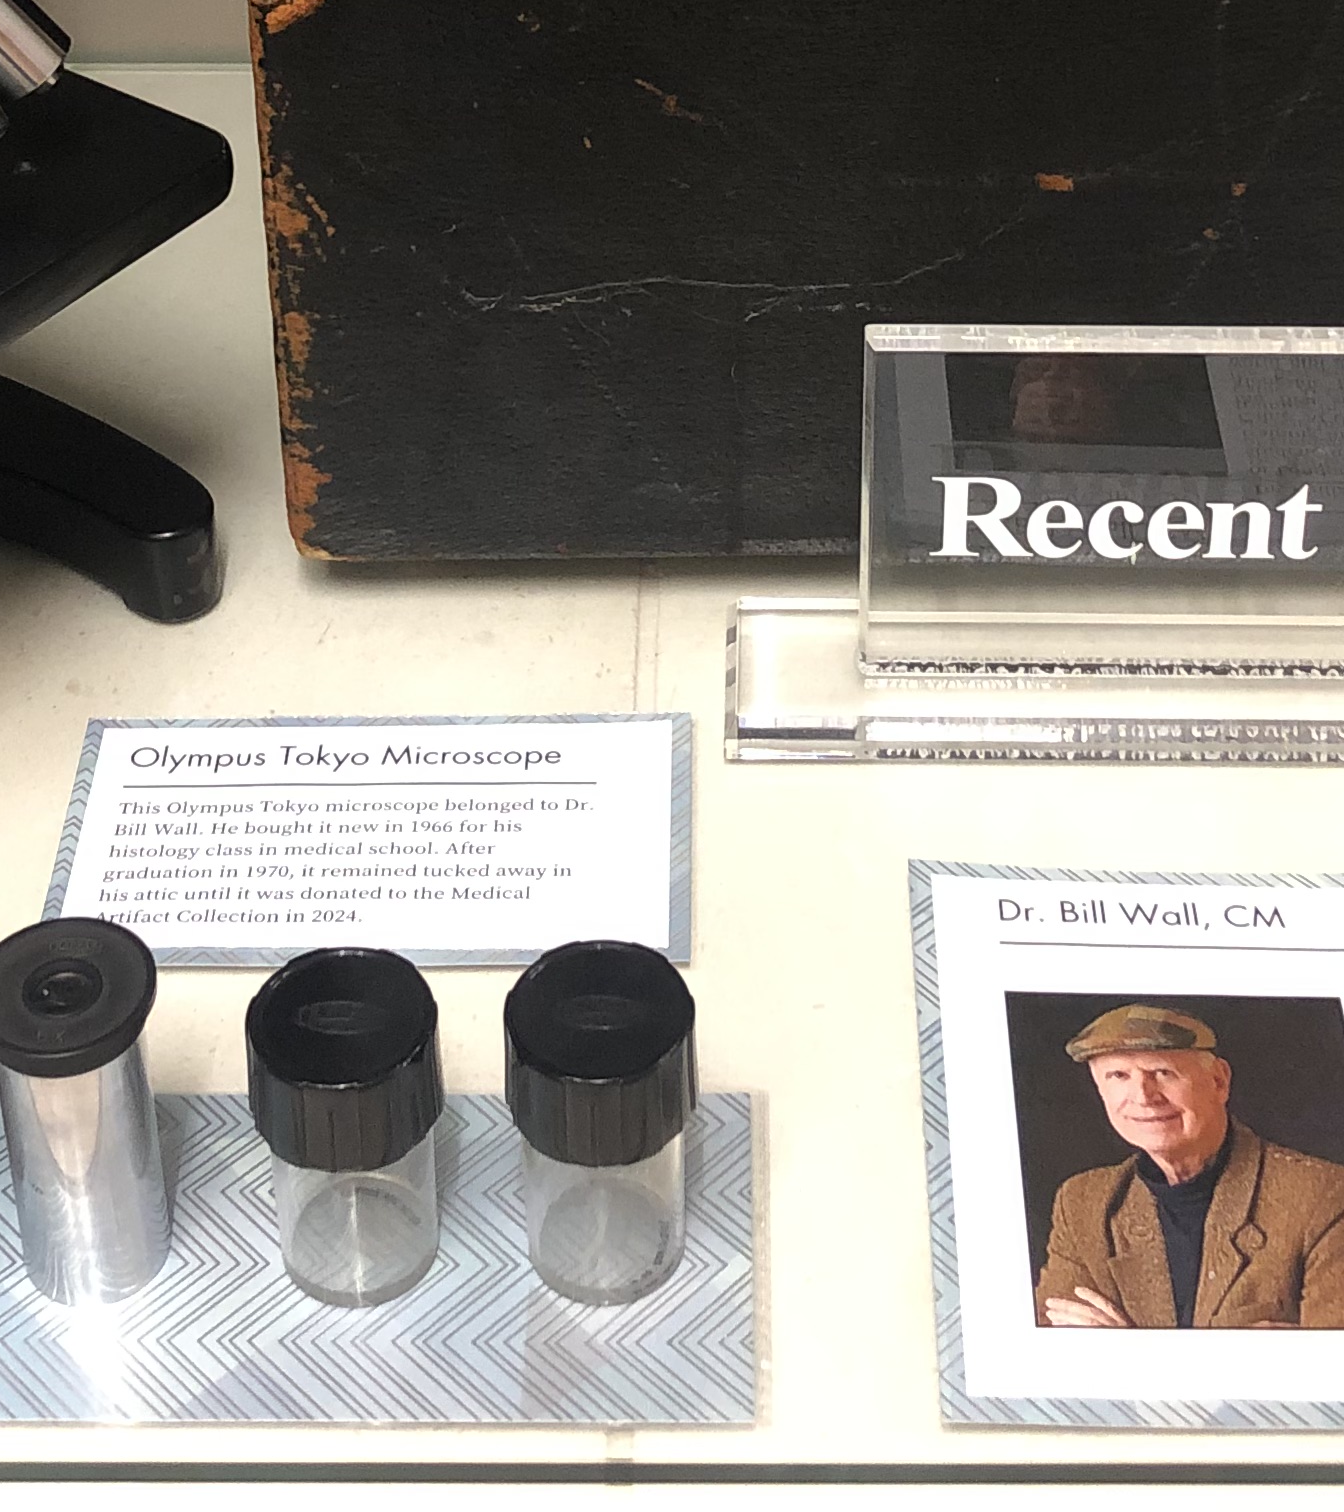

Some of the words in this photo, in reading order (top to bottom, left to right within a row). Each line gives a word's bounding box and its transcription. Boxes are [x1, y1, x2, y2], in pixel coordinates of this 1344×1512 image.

[930, 475, 1322, 561] Recent
[130, 744, 266, 775] Olympus
[279, 743, 370, 773] Tokyo
[380, 744, 562, 771] Microscope
[118, 800, 161, 815] This
[166, 800, 254, 818] Olympus
[259, 799, 320, 817] Tokyo
[325, 799, 439, 815] microscope
[444, 797, 534, 815] belonged
[540, 799, 559, 812] to
[565, 798, 594, 812] Dr.
[114, 822, 147, 837] Bill
[154, 822, 204, 837] Wall.
[210, 821, 239, 836] He
[244, 819, 313, 837] bought
[319, 820, 331, 835] it
[338, 823, 380, 835] new
[384, 819, 403, 834] in
[411, 819, 453, 833] 1966
[459, 818, 485, 833] for
[493, 818, 523, 833] his
[108, 843, 201, 861] histology
[205, 842, 253, 857] class
[258, 842, 277, 857] in
[284, 841, 363, 857] medical
[368, 840, 439, 855] school.
[445, 840, 496, 856] After
[102, 865, 212, 884] graduation
[219, 864, 238, 879] in
[247, 865, 294, 881] 1970,
[301, 863, 314, 879] it
[321, 863, 417, 878] remained
[423, 862, 490, 878] tucked
[495, 866, 547, 881] away
[553, 863, 572, 878] in
[98, 888, 129, 903] his
[133, 887, 179, 902] attic
[184, 886, 231, 902] until
[237, 886, 250, 901] it
[256, 889, 295, 900] was
[300, 885, 382, 900] donated
[388, 887, 407, 900] to
[413, 885, 445, 901] the
[451, 885, 531, 901] Medical
[176, 908, 279, 924] Collection
[286, 908, 305, 924] in
[311, 909, 362, 923] 2024.
[998, 898, 1045, 923] Dr.
[1059, 899, 1107, 925] Bill
[1118, 901, 1210, 931] Wall,
[1223, 904, 1286, 929] CM
